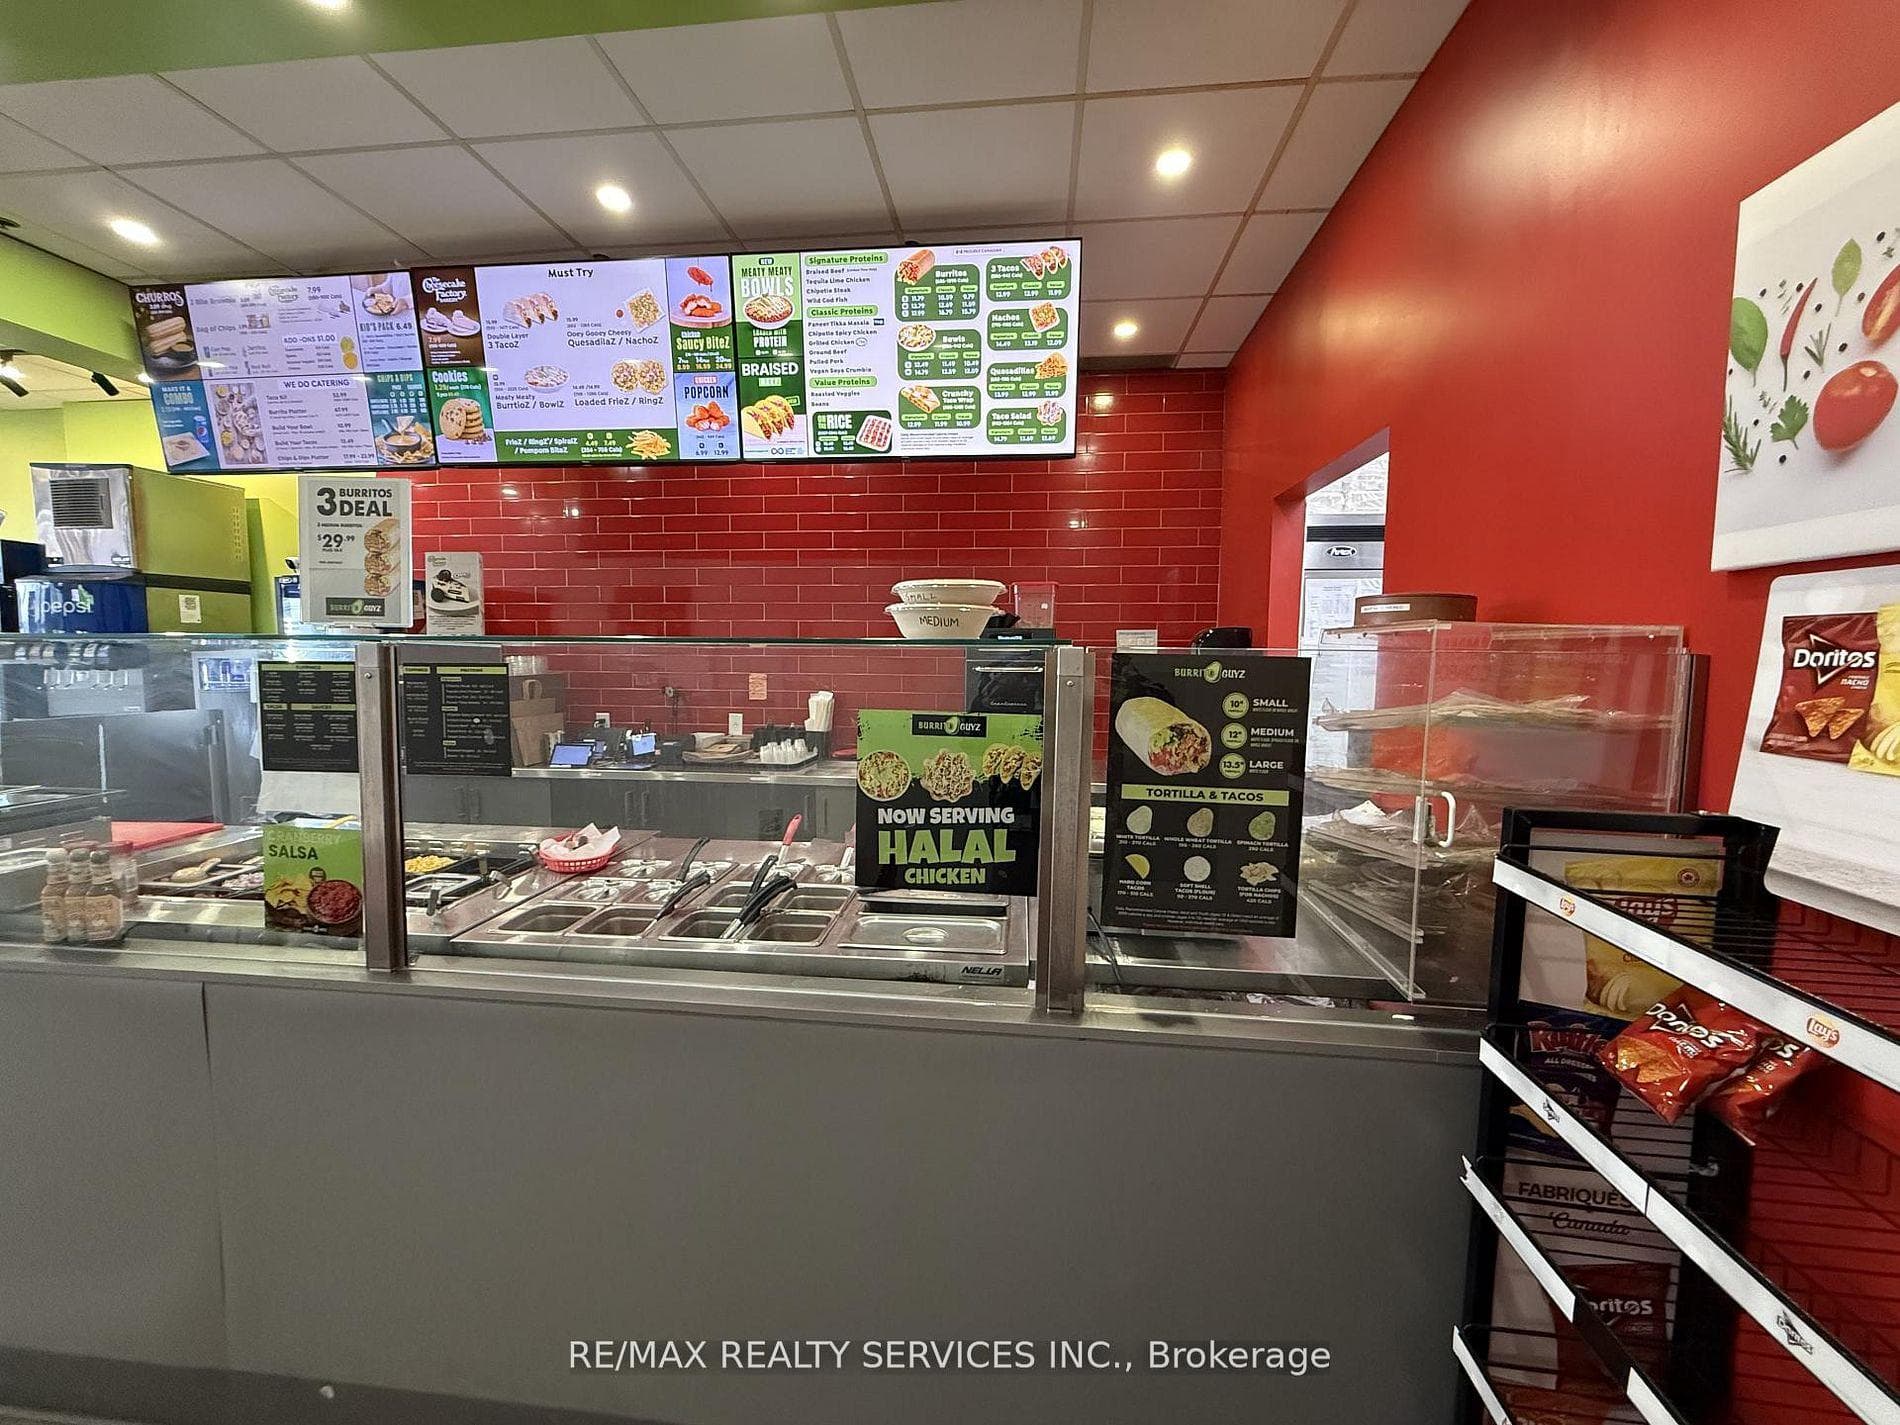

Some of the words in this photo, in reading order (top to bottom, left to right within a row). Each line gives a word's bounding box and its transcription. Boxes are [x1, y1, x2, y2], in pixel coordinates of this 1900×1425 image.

[809, 256, 847, 264] Signature
[850, 254, 883, 263] Proteins
[548, 269, 574, 278] Must
[576, 268, 594, 278] Try
[742, 268, 765, 278] MEATY
[768, 267, 792, 276] MEATY
[740, 277, 794, 298] BOWLS
[136, 291, 184, 306] CHURROS
[378, 322, 394, 331] PACK
[396, 322, 412, 330] 6.49
[568, 338, 616, 347] QuesadilaZ
[626, 337, 658, 346] NachoZ
[676, 338, 704, 350] Saucy
[706, 336, 730, 349] BiteZ
[754, 336, 788, 348] PROTEIN
[742, 362, 799, 376] BRAISED
[990, 368, 1034, 376] Quesadillas
[378, 374, 394, 382] CHIPS
[400, 374, 412, 382] DIPS
[432, 371, 468, 382] Cookies
[312, 379, 350, 387] CATERING
[685, 386, 728, 398] POPCORN
[163, 393, 194, 405] COMBO
[540, 400, 564, 408] BowlZ
[639, 396, 664, 406] RingZ
[827, 415, 852, 429] RICE
[340, 488, 392, 498] BURRITOS
[317, 488, 337, 516] 3
[340, 500, 392, 517] DEAL
[904, 592, 937, 602] SMALL
[41, 600, 94, 618] pepsi
[920, 616, 960, 628] MEDIUM
[1793, 649, 1876, 668] Doritos
[1222, 670, 1246, 678] GUYZ
[1253, 698, 1288, 708] SMALL
[960, 723, 981, 732] GUYZ
[1251, 728, 1294, 737] MEDIUM
[1250, 760, 1284, 770] LARGE
[1146, 788, 1206, 800] TORTILLA
[1209, 790, 1218, 800] &
[1221, 791, 1264, 802] TACOS
[878, 808, 926, 824] NOW
[930, 807, 1014, 824] SERVING
[878, 828, 1016, 864] HALAL
[269, 844, 318, 860] SALSA
[904, 868, 986, 884] CHICKEN
[961, 966, 1003, 976] NELLA
[1553, 1213, 1631, 1237] Canada
